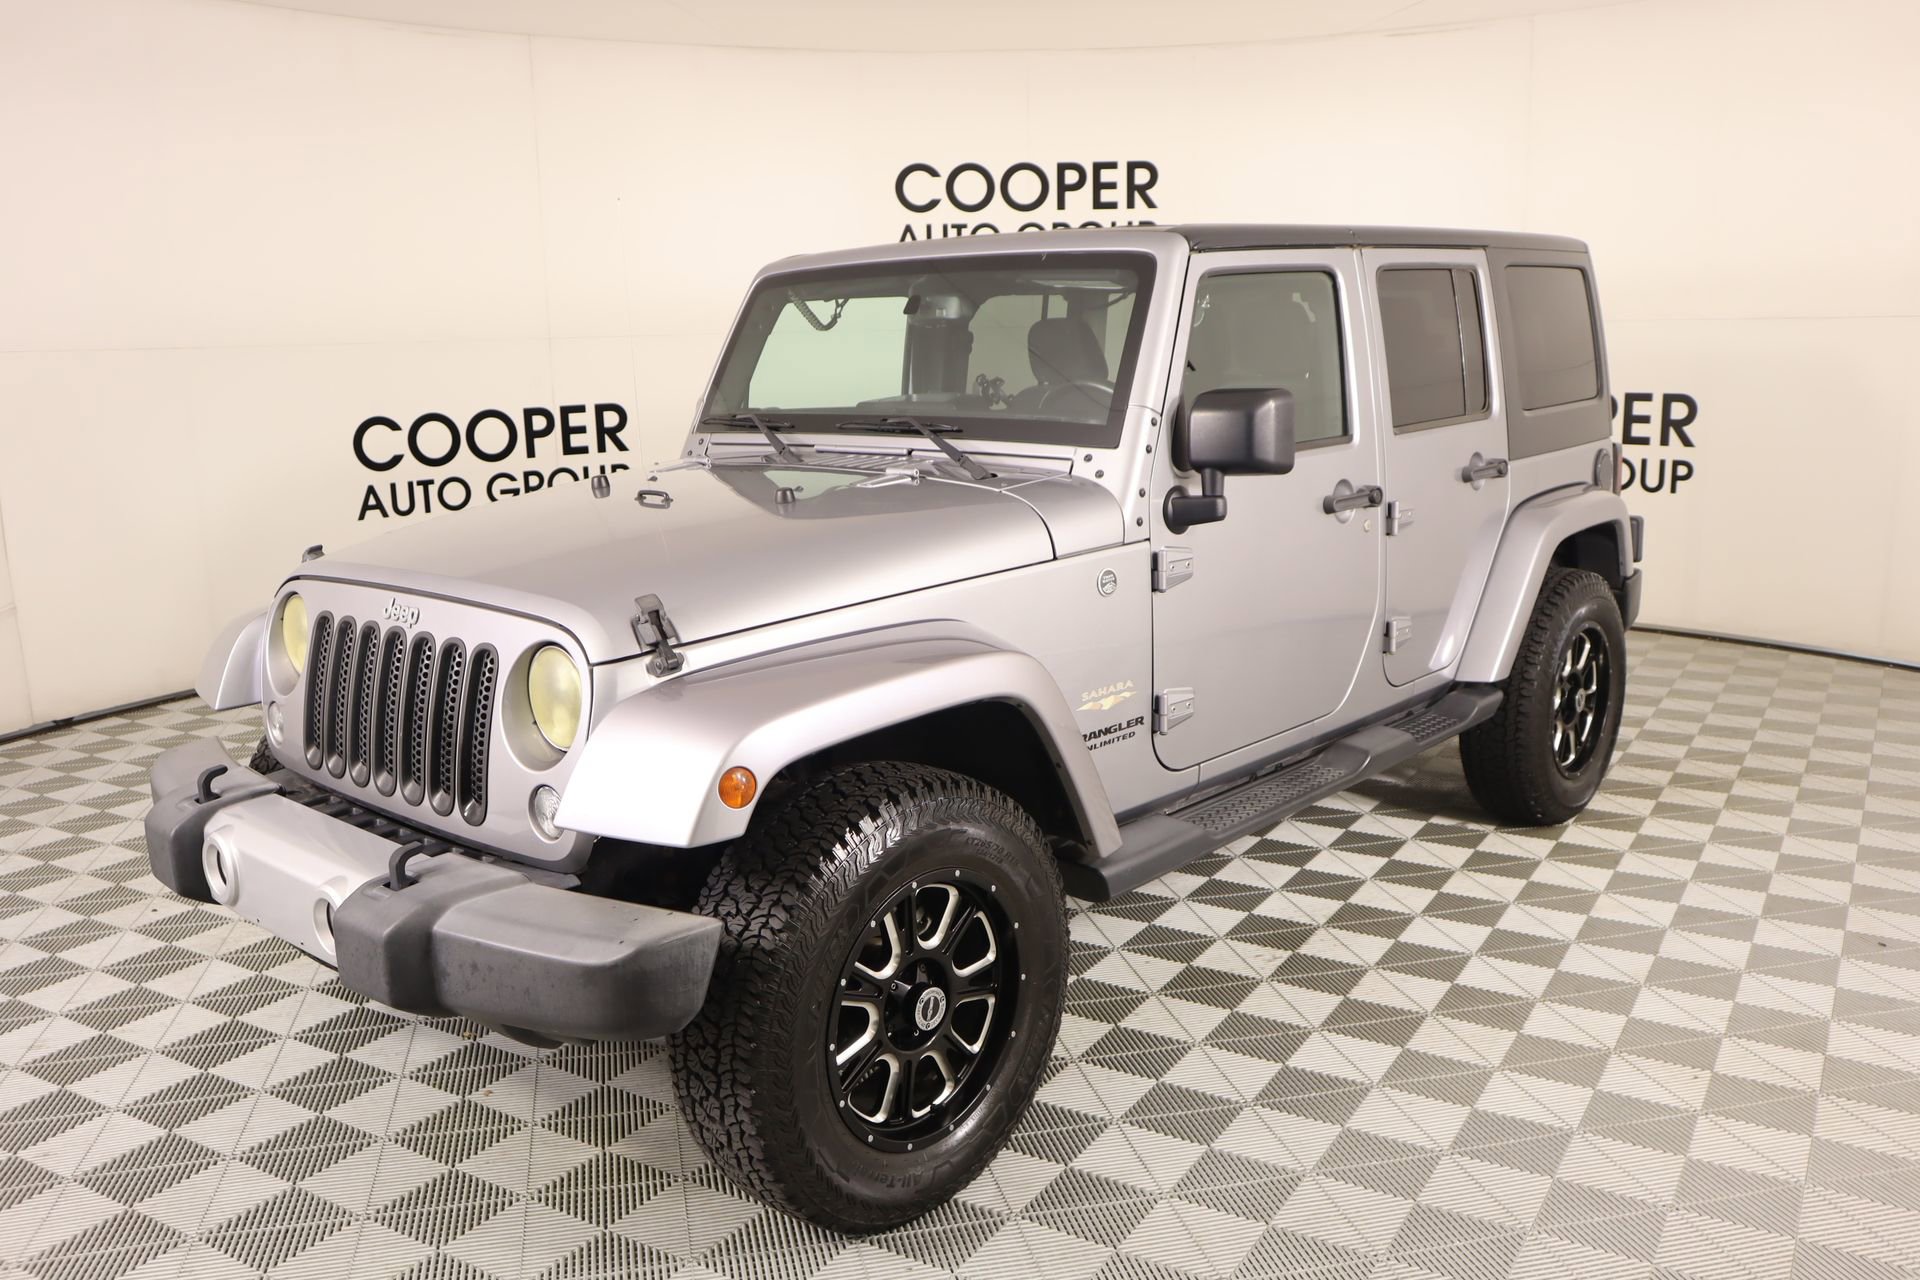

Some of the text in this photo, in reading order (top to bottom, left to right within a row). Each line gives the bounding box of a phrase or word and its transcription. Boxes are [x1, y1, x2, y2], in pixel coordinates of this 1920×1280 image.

[894, 161, 1159, 213] COOPER
[353, 403, 630, 472] COOPER
[357, 476, 472, 521] AUTO
[384, 597, 420, 629] Jeep
[1081, 679, 1134, 701] SAHARA
[1087, 731, 1136, 751] NLIMITED
